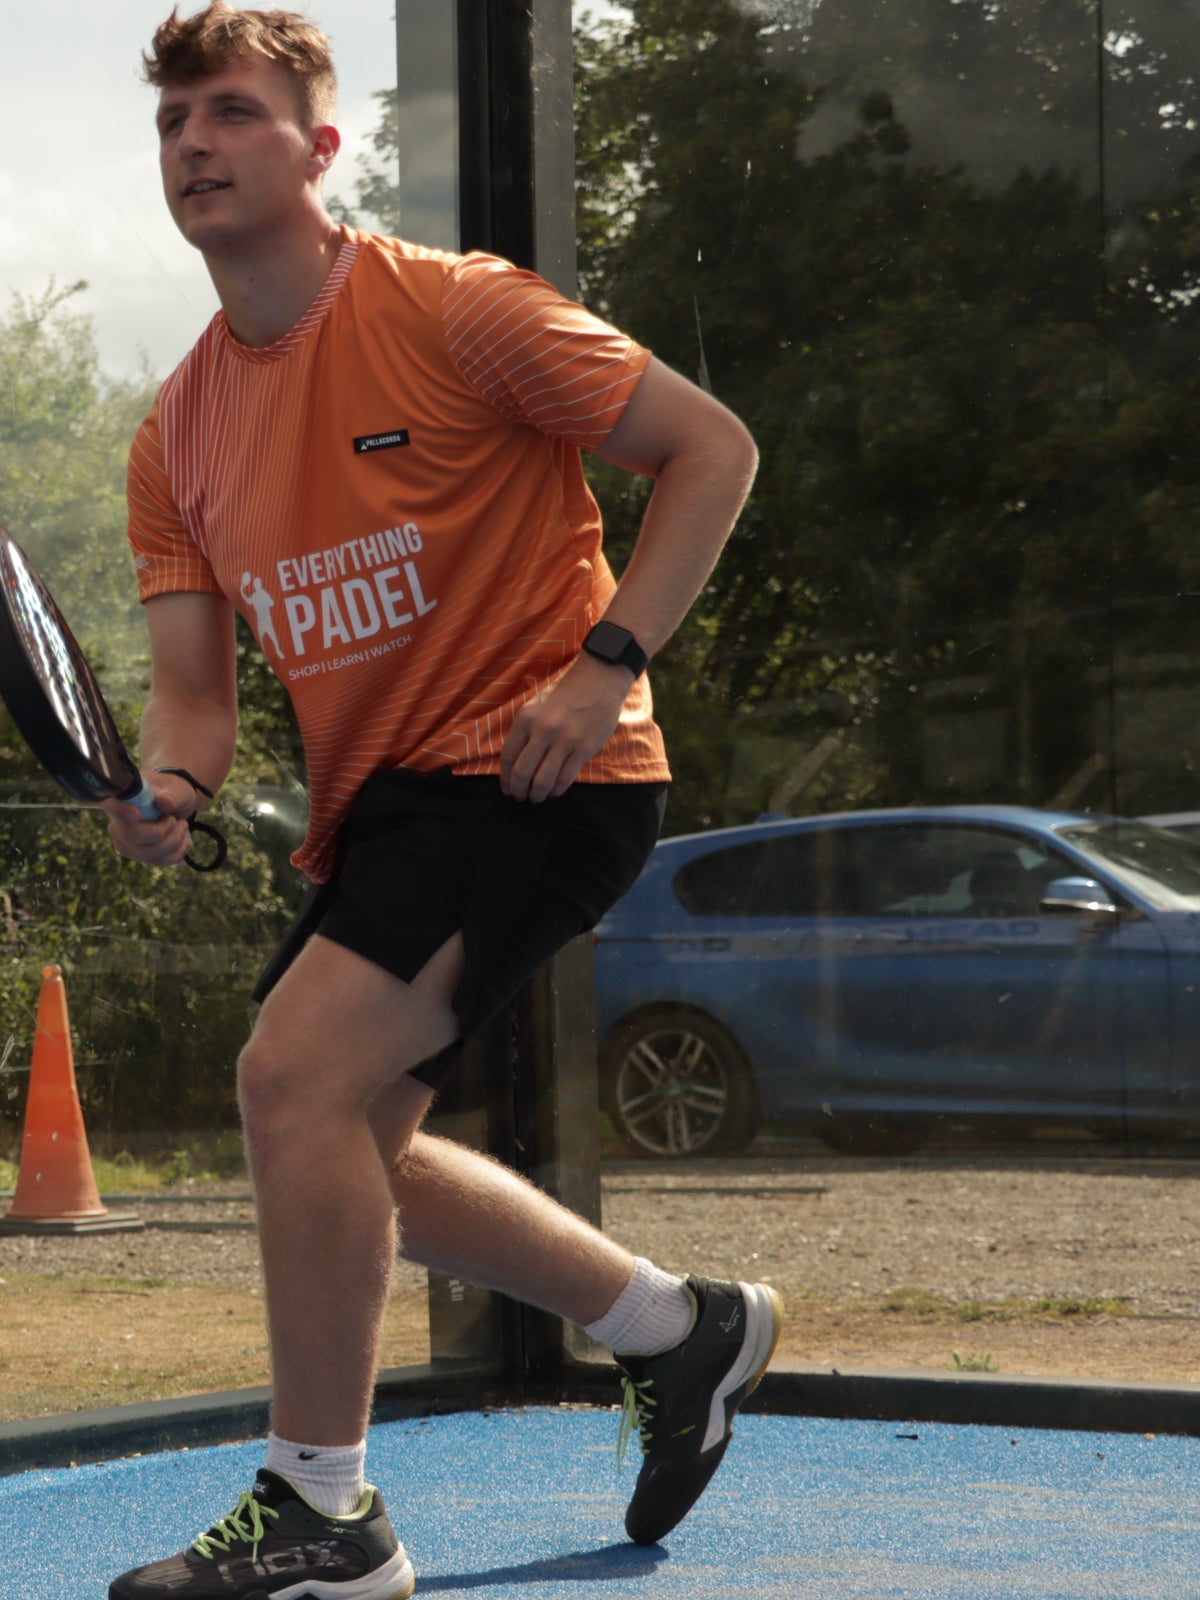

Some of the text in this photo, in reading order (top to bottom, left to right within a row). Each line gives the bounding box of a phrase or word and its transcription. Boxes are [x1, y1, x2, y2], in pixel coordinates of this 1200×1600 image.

[277, 522, 423, 592] EVERYTHING
[284, 561, 438, 656] PADEL
[288, 662, 321, 681] SHOP
[327, 652, 364, 671] LEARN
[370, 634, 412, 657] WATCH
